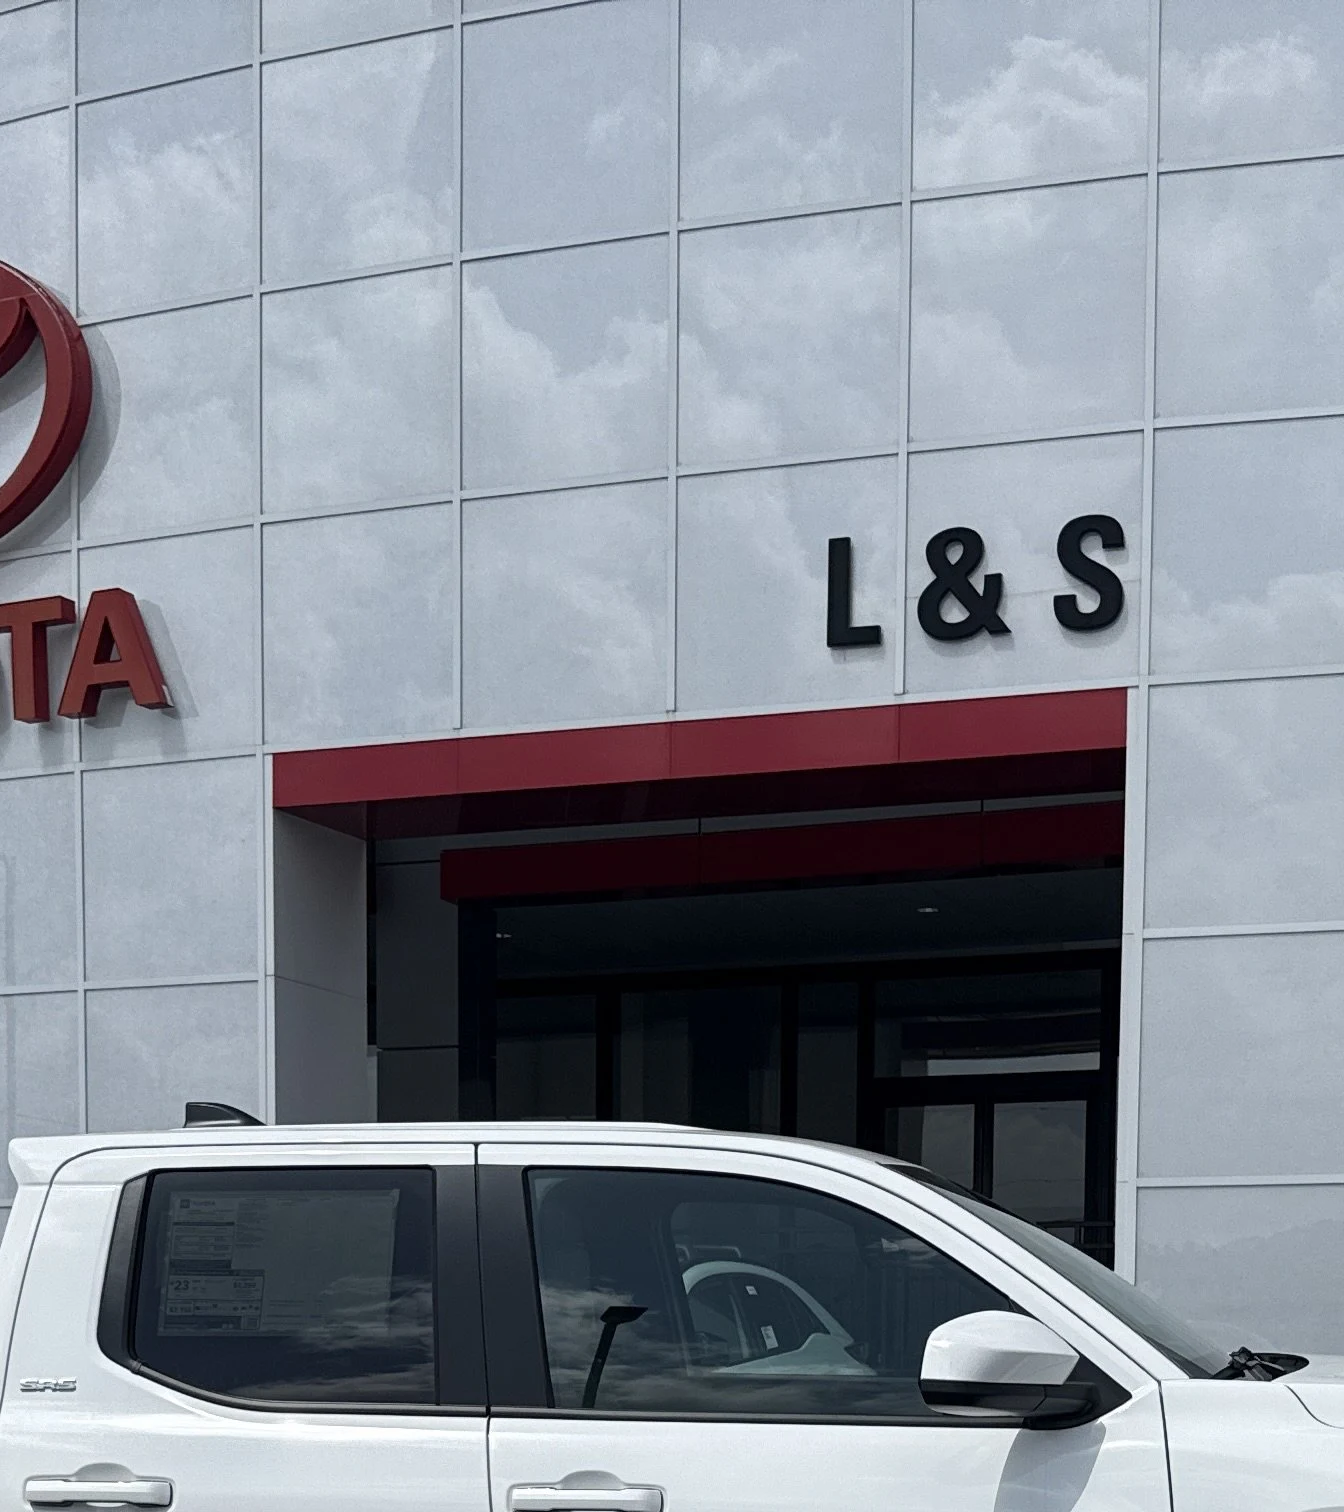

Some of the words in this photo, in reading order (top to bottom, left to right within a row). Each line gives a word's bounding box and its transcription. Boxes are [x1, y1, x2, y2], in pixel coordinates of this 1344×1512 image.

[827, 536, 882, 648] L
[917, 526, 1012, 641] &
[1053, 514, 1125, 631] S
[19, 1377, 77, 1392] SR5
